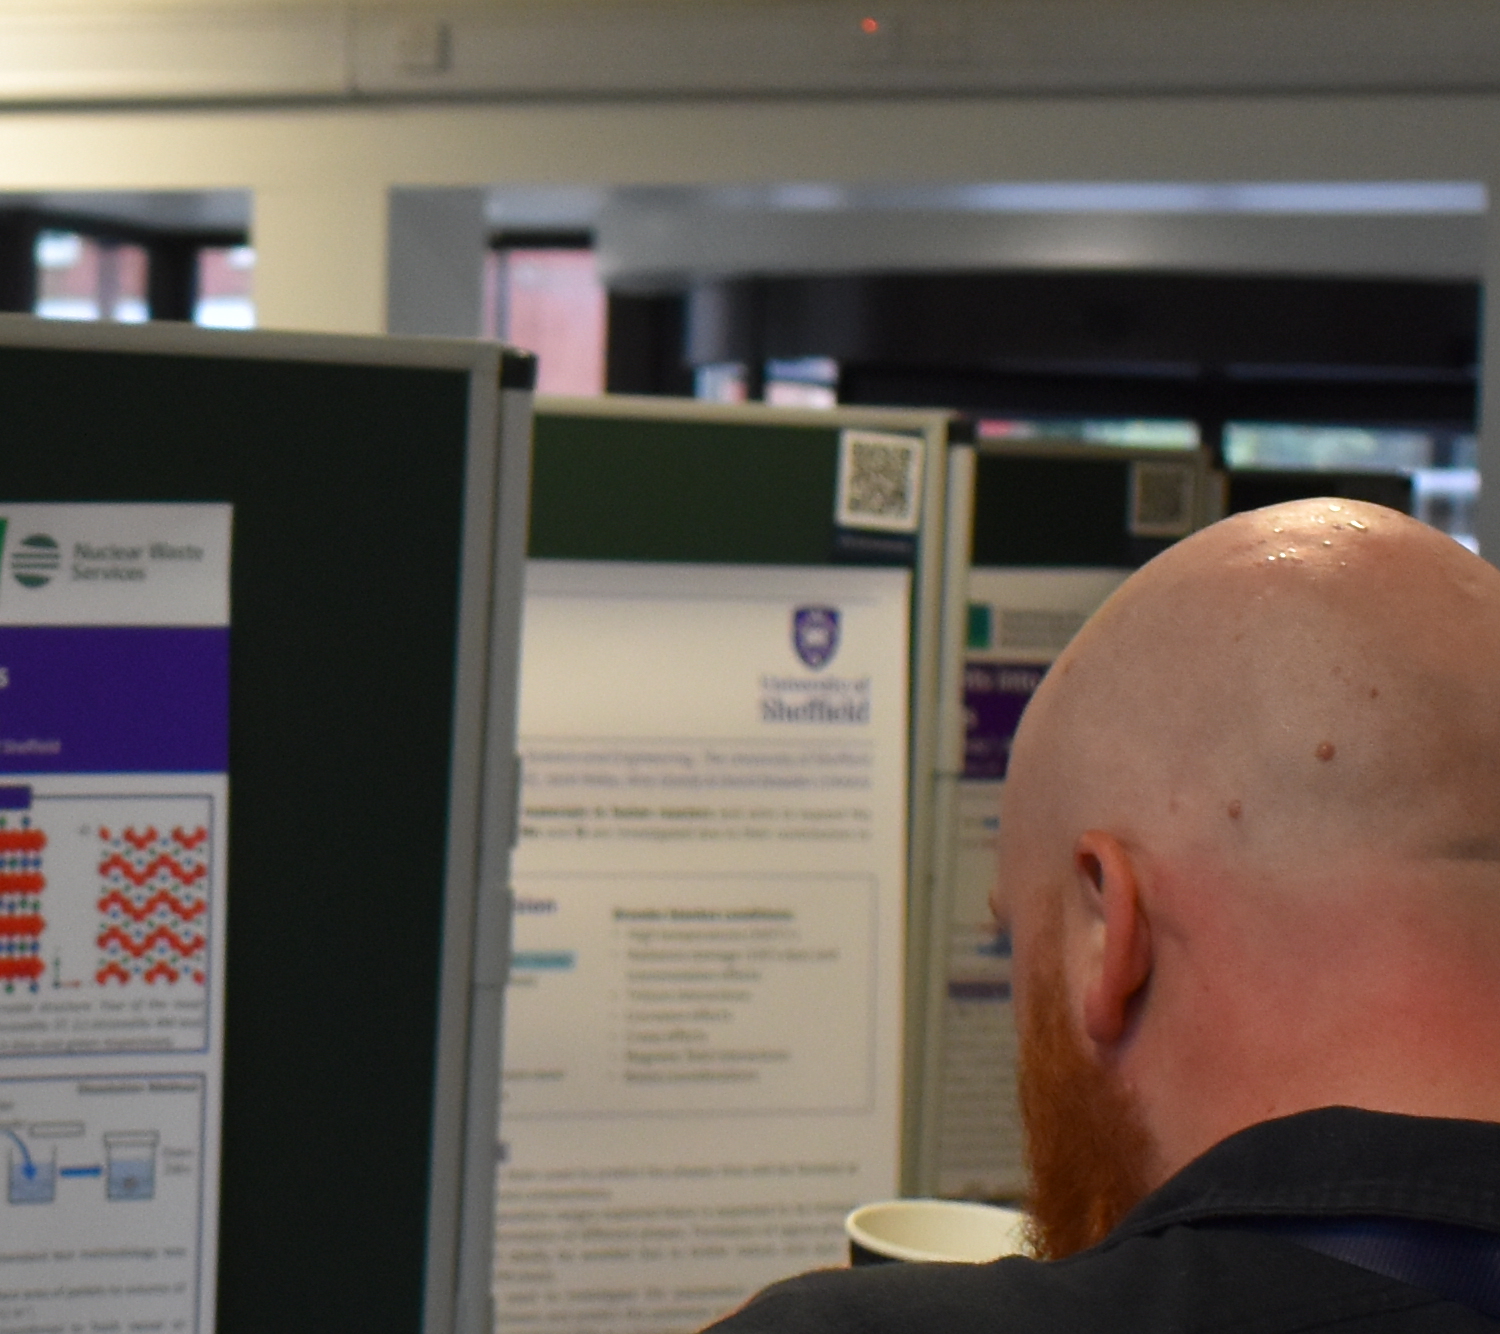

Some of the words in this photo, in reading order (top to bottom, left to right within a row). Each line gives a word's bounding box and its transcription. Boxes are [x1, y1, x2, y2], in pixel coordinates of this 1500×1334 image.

[74, 541, 144, 560] Nuclear
[149, 541, 205, 561] Waste
[71, 564, 146, 582] Services
[760, 675, 846, 697] University
[851, 675, 871, 694] of
[761, 696, 871, 725] Sheffield
[3, 740, 61, 755] Sheffield
